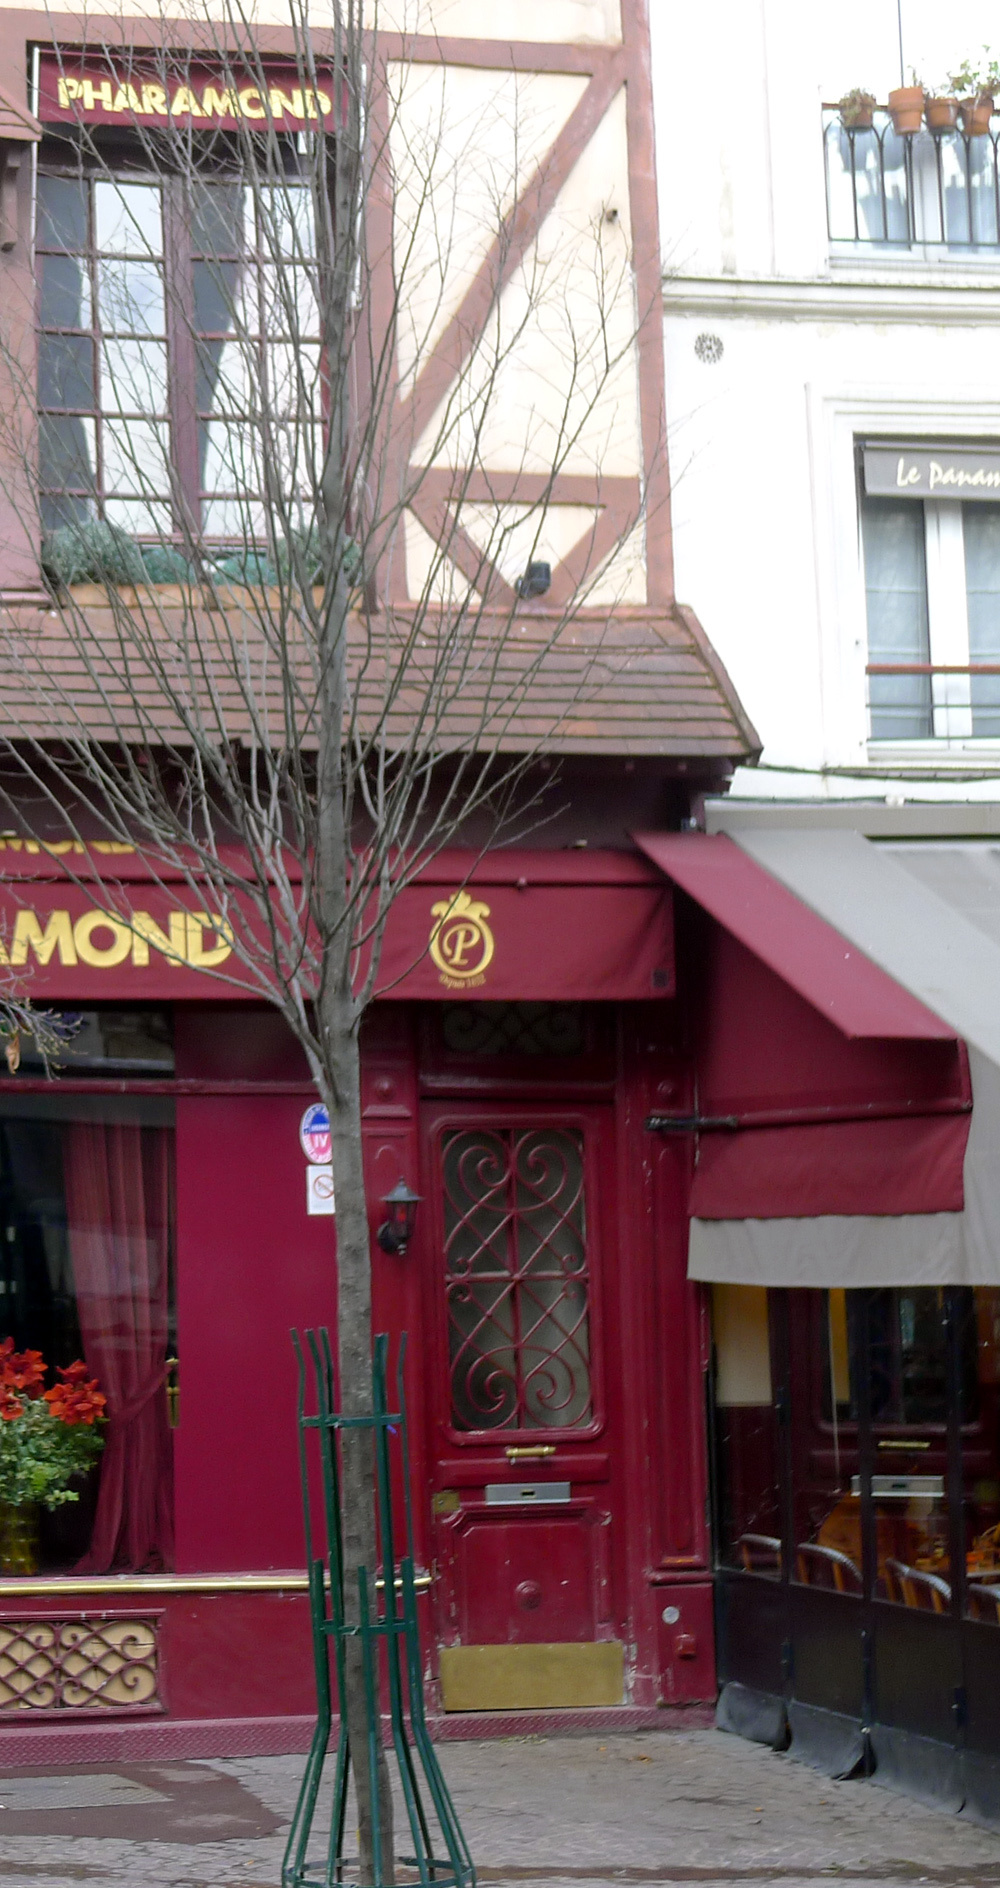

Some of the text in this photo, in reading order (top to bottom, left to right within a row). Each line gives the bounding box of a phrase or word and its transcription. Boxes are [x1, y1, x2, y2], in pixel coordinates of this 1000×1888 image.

[57, 77, 332, 120] PHARAMOND
[896, 457, 921, 487] Le
[442, 923, 480, 965] P
